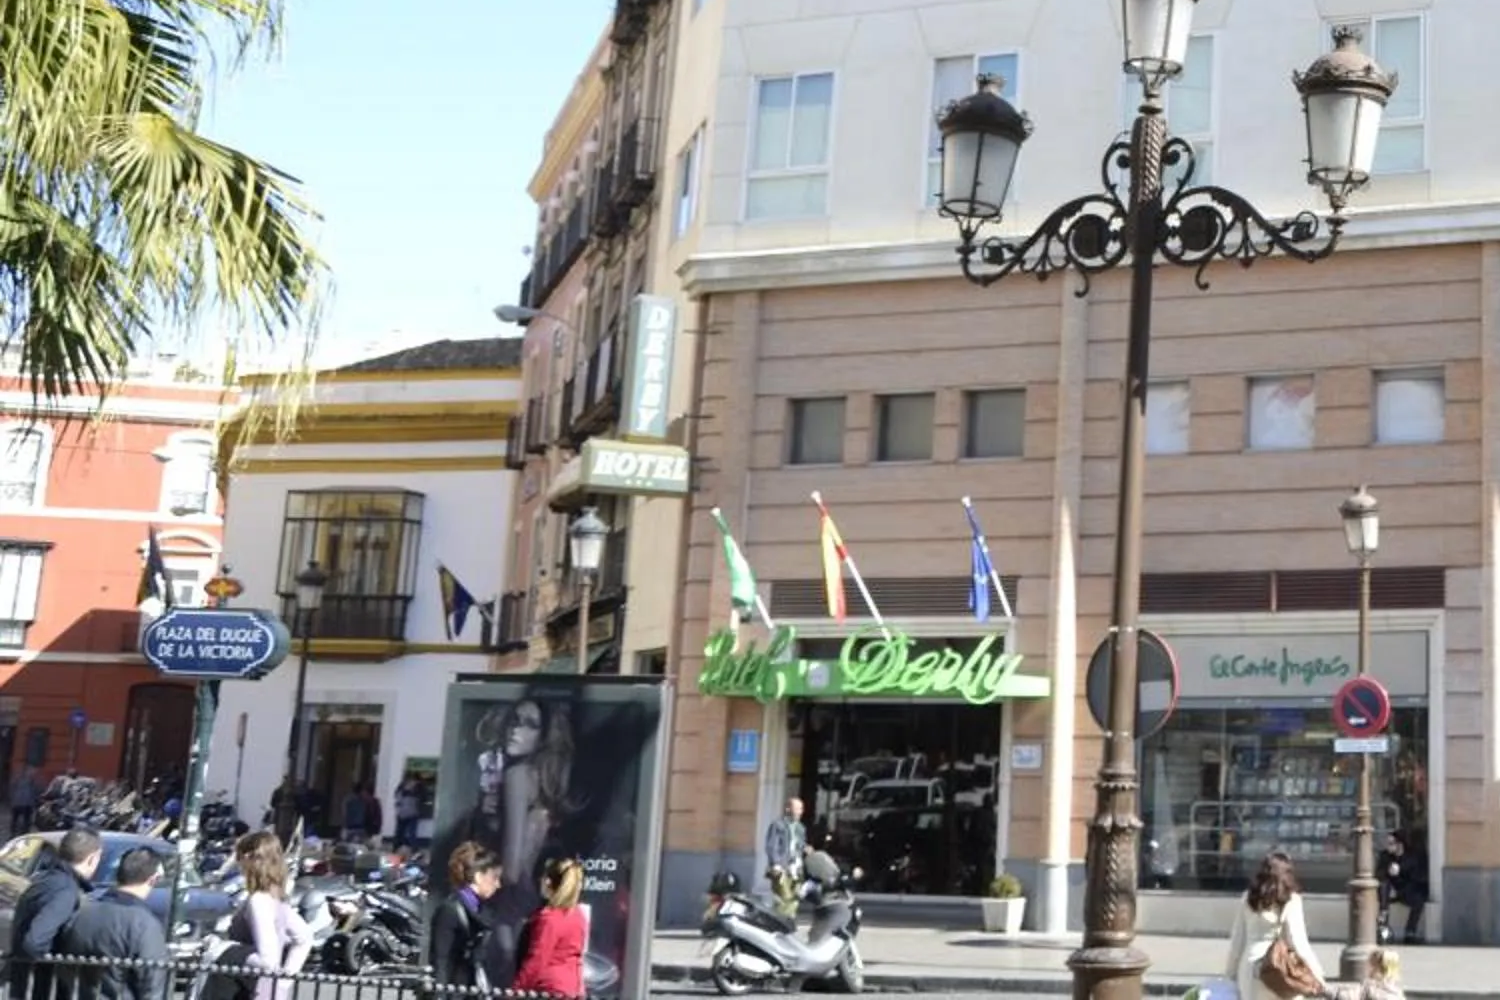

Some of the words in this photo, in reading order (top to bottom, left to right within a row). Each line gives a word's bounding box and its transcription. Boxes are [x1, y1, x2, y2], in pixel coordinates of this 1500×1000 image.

[637, 306, 670, 431] DERBY
[592, 451, 689, 480] HOTEL
[156, 626, 193, 641] PLAZA
[196, 627, 215, 642] DEL
[220, 628, 263, 643] DUQUE
[158, 643, 174, 657] DE
[178, 644, 194, 658] LA
[198, 645, 255, 660] VICTORIA
[840, 625, 1024, 705] Derby
[1209, 654, 1230, 679] El
[1231, 654, 1277, 678] Corte
[1278, 647, 1350, 685] Inglés
[584, 876, 615, 891] Klein
